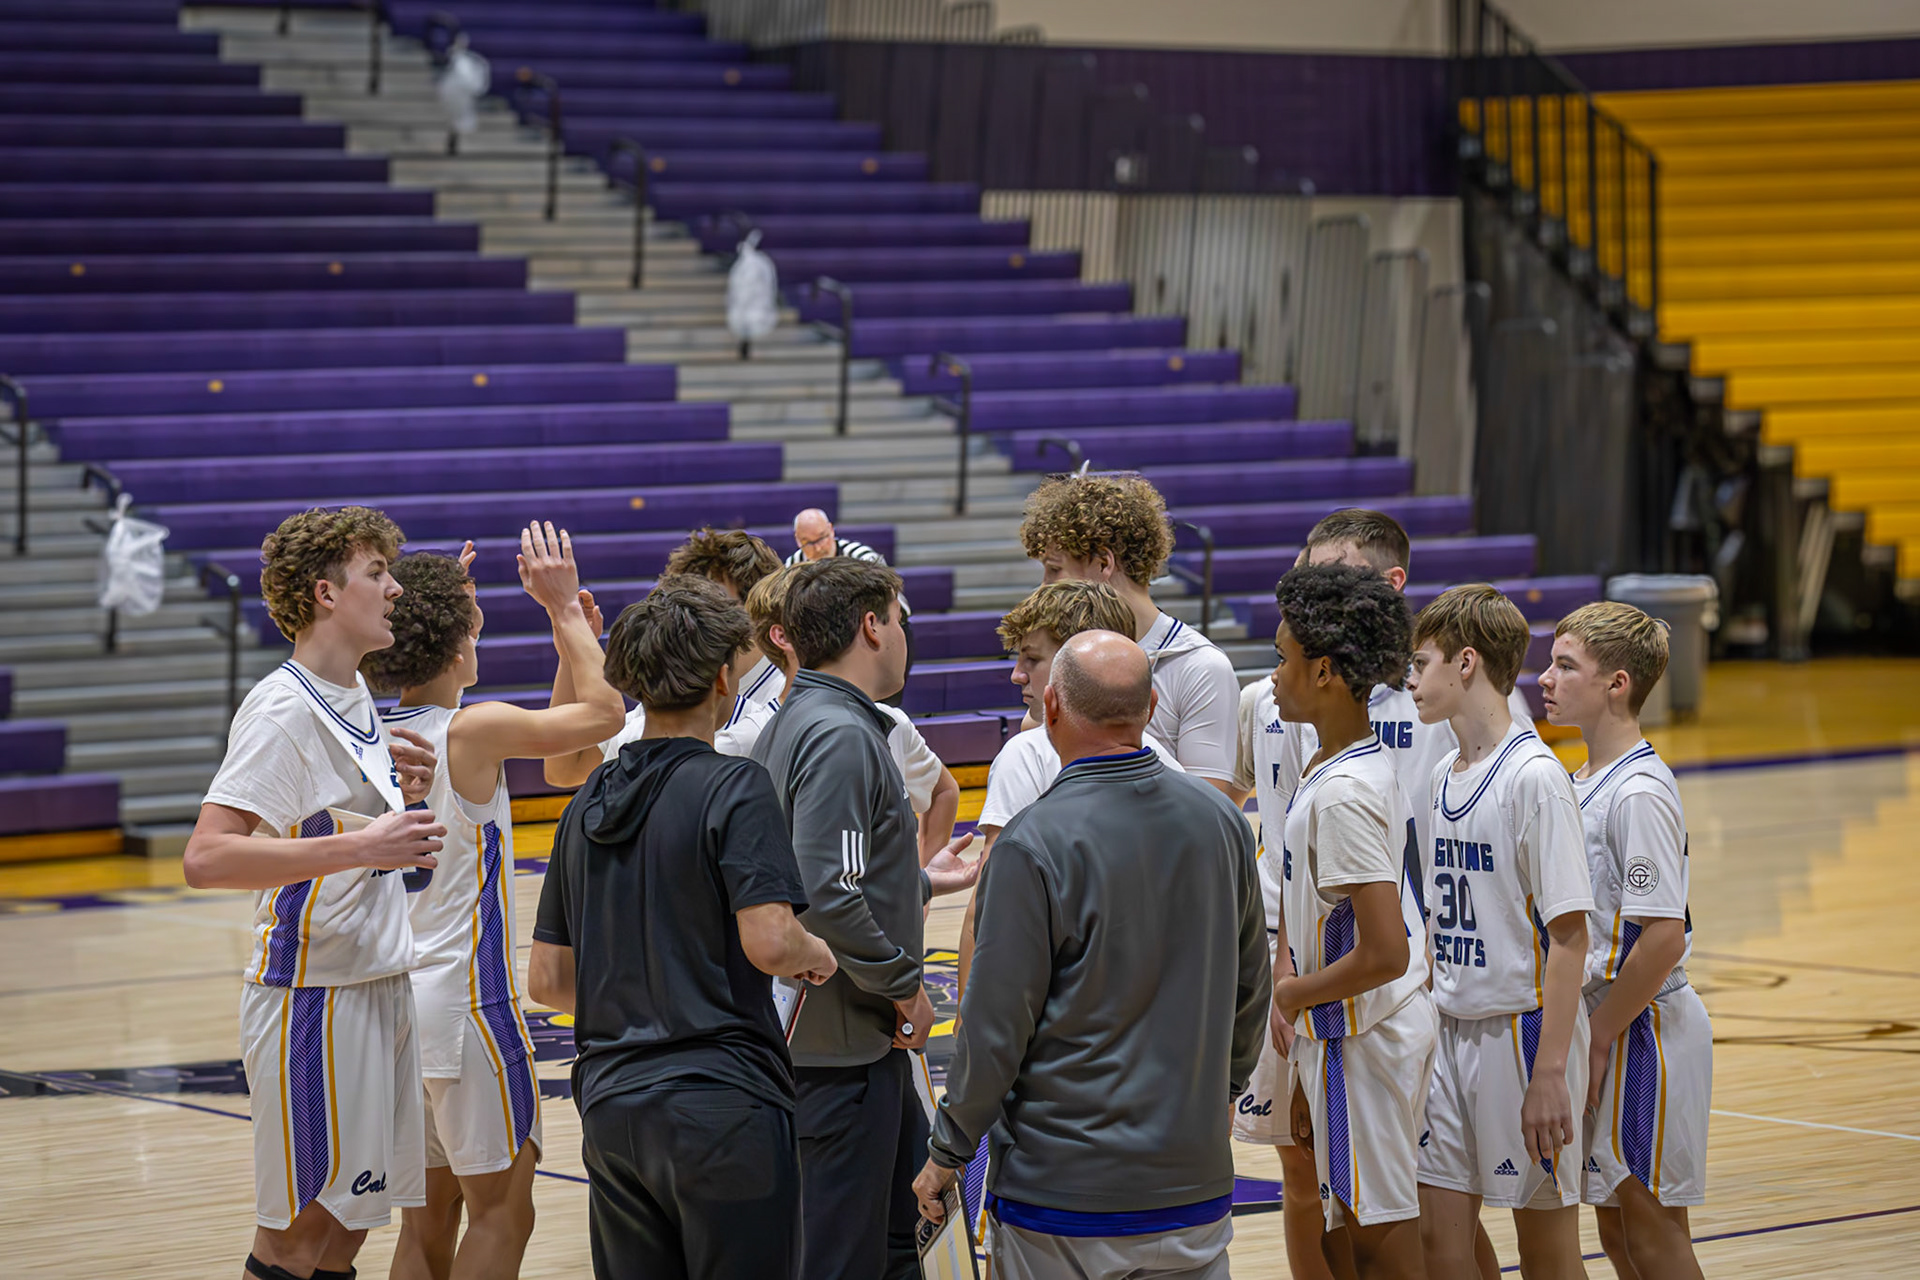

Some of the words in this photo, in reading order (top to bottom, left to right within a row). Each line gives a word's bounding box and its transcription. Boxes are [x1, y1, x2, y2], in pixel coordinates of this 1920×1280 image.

[1434, 872, 1477, 932] 30
[1433, 933, 1487, 968] SCOTS
[1238, 1093, 1272, 1117] Cal
[351, 1169, 387, 1196] Cal
[1493, 1168, 1519, 1176] adidas
